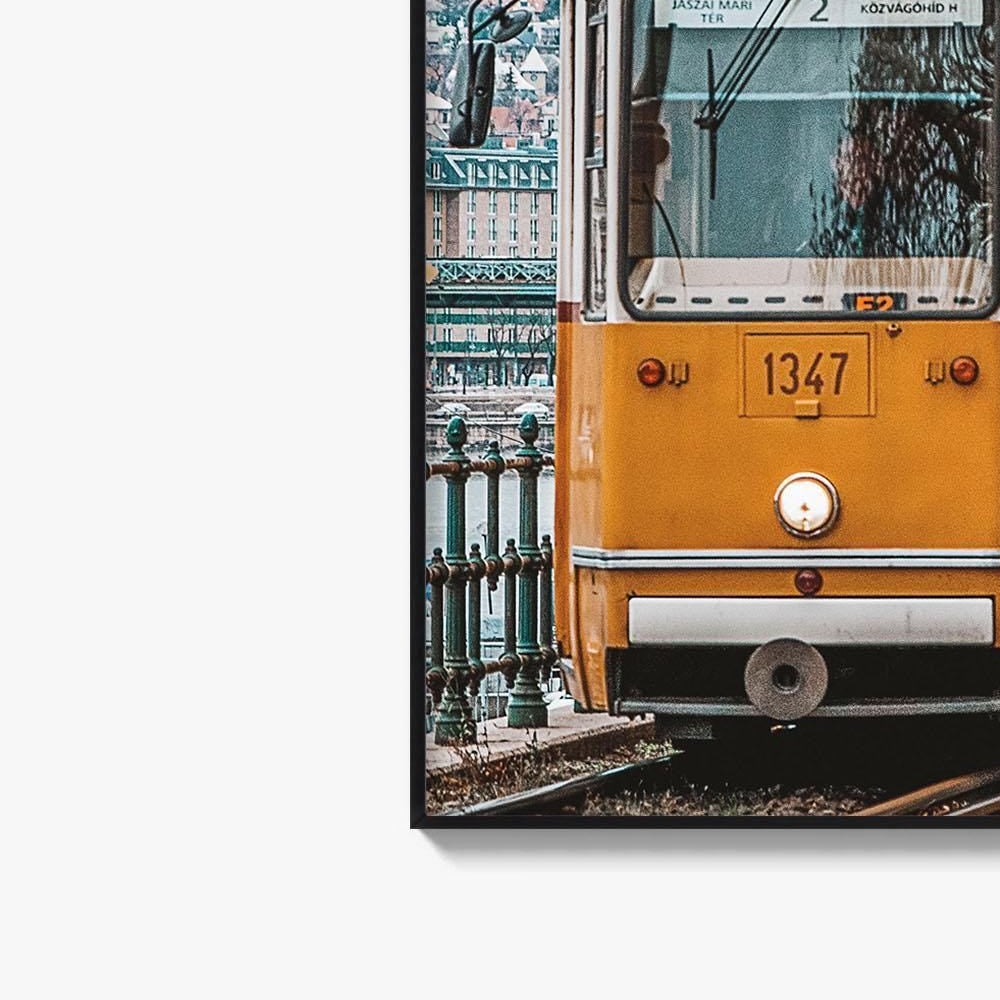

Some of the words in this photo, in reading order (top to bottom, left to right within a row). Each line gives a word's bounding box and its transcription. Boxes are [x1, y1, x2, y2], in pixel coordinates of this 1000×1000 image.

[718, 0, 753, 10] MARI
[949, 3, 958, 13] H
[764, 352, 849, 395] 1347
